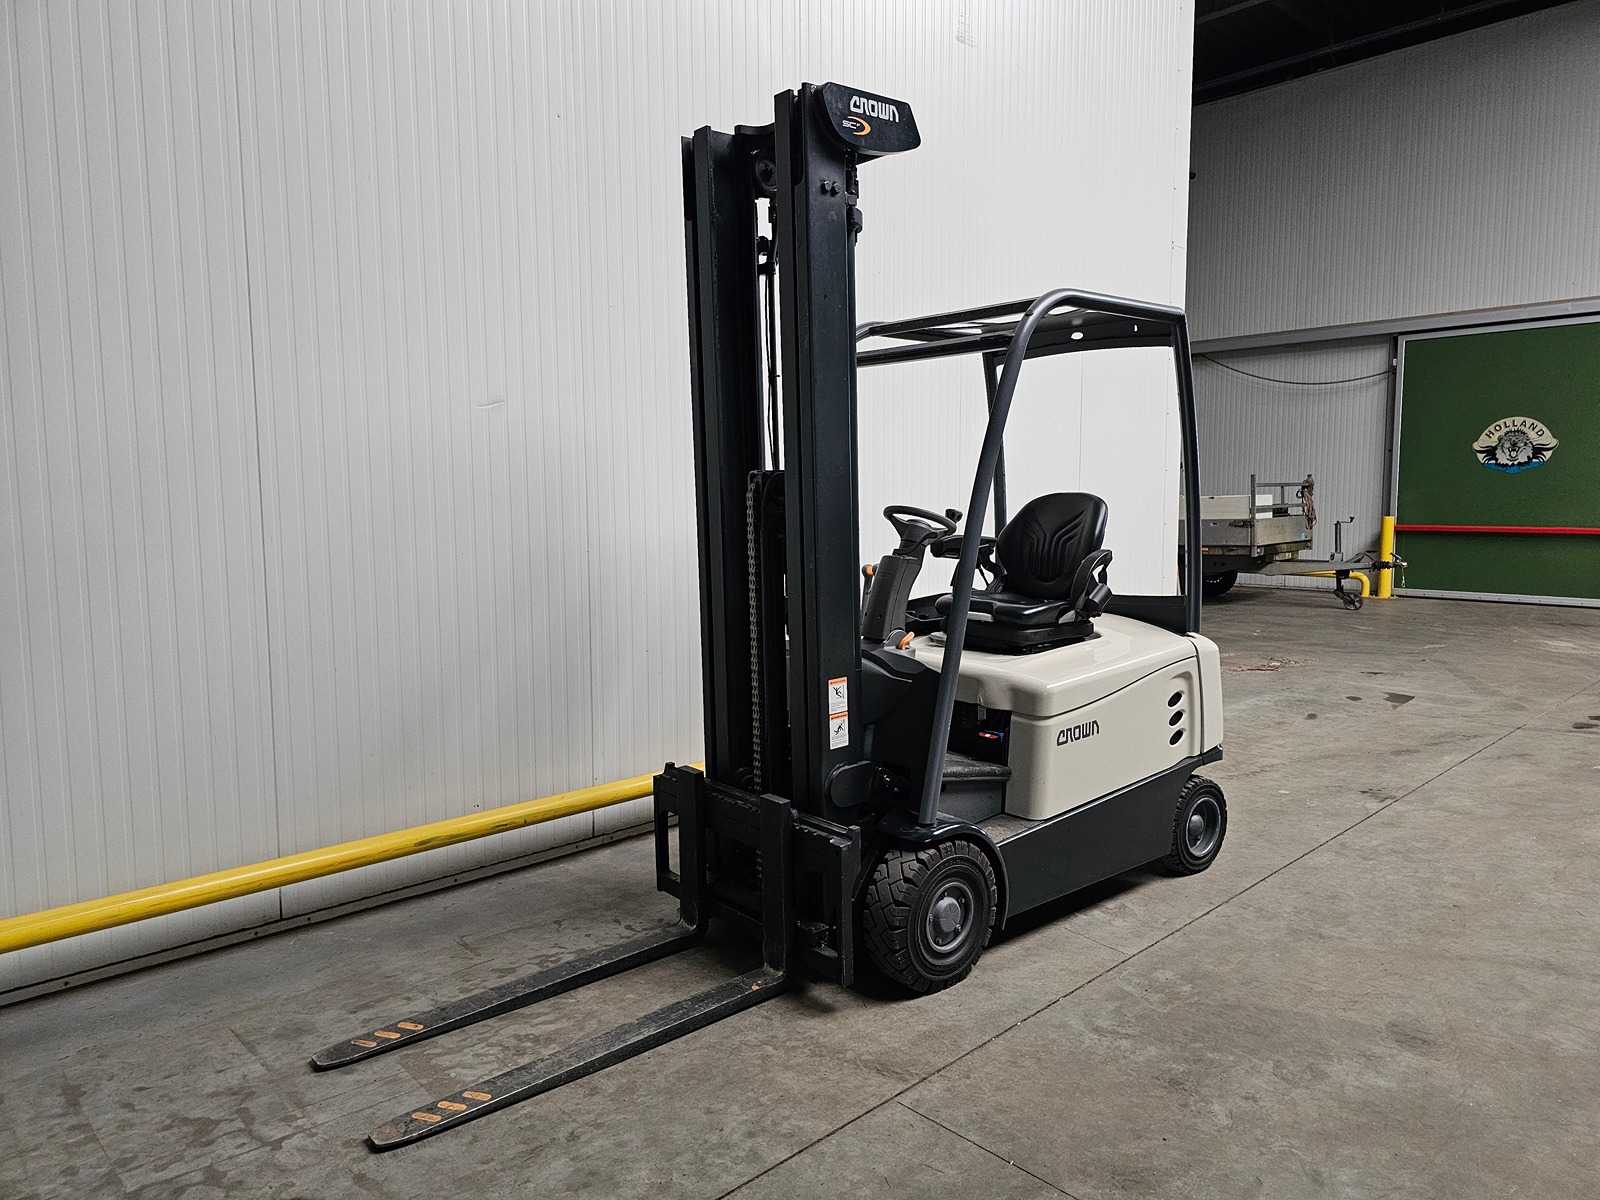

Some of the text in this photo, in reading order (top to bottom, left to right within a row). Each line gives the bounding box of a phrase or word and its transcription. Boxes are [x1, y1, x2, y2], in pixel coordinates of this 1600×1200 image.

[849, 95, 900, 123] CROWN
[1485, 419, 1545, 439] HOLLAND
[1056, 719, 1100, 746] CROWN
